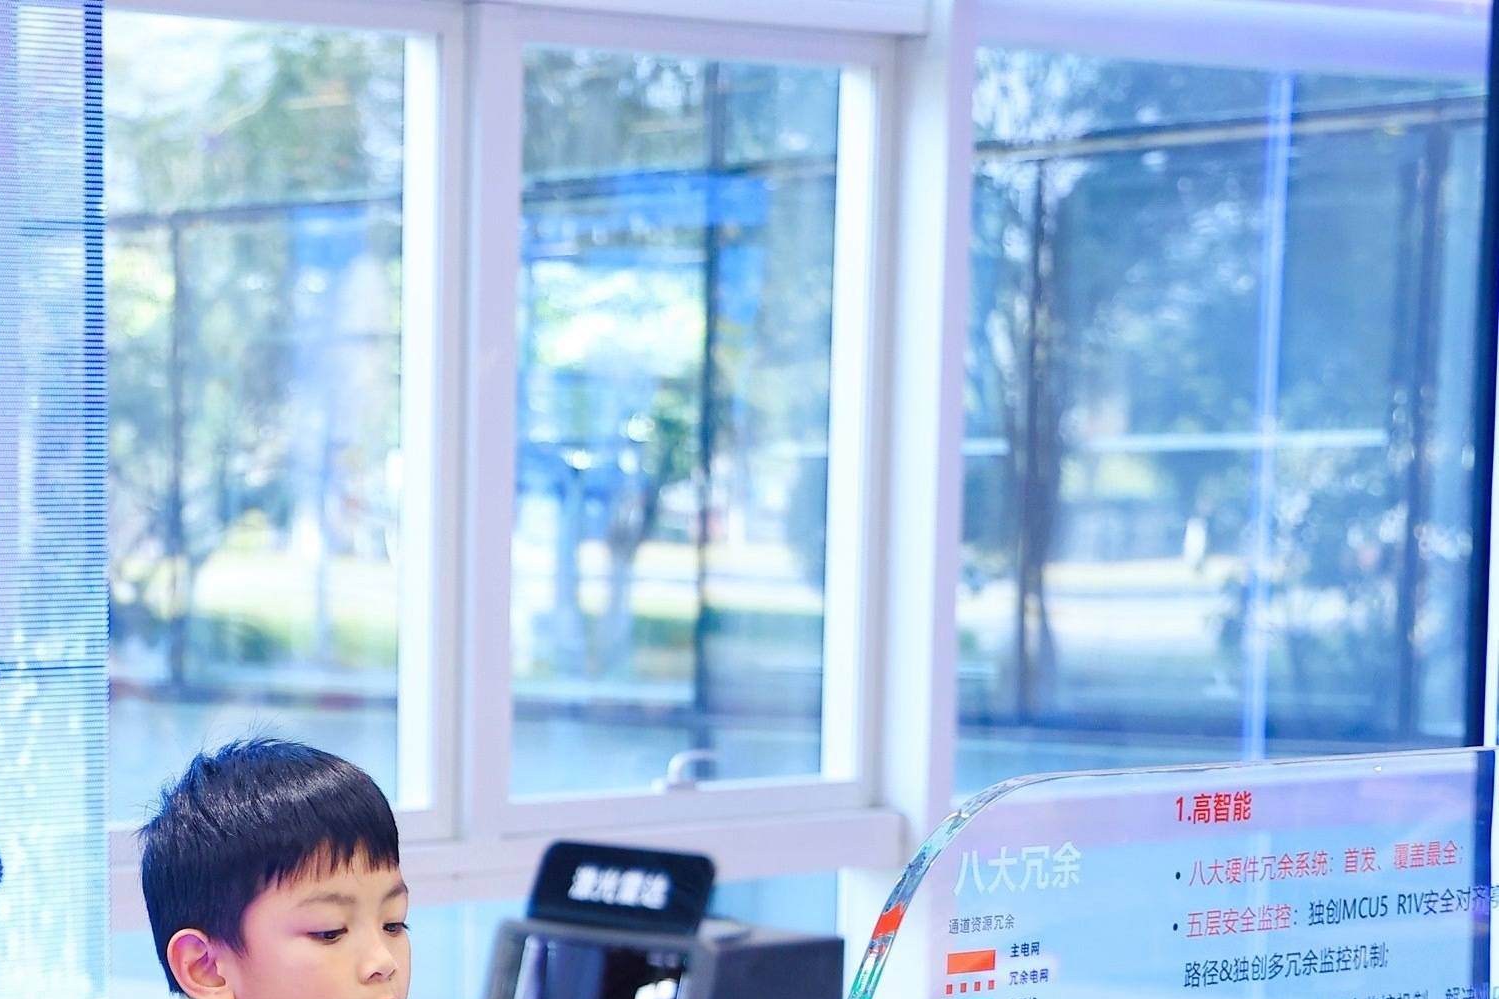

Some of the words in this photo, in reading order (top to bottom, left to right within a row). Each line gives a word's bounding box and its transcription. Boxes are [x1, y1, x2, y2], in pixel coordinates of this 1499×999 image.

[1175, 791, 1252, 825] 1.高智能
[953, 841, 1081, 896] 八大冗余
[948, 914, 1015, 935] 通道资源冗余
[1009, 941, 1040, 958] 主电网
[1008, 968, 1050, 986] 冗余电网
